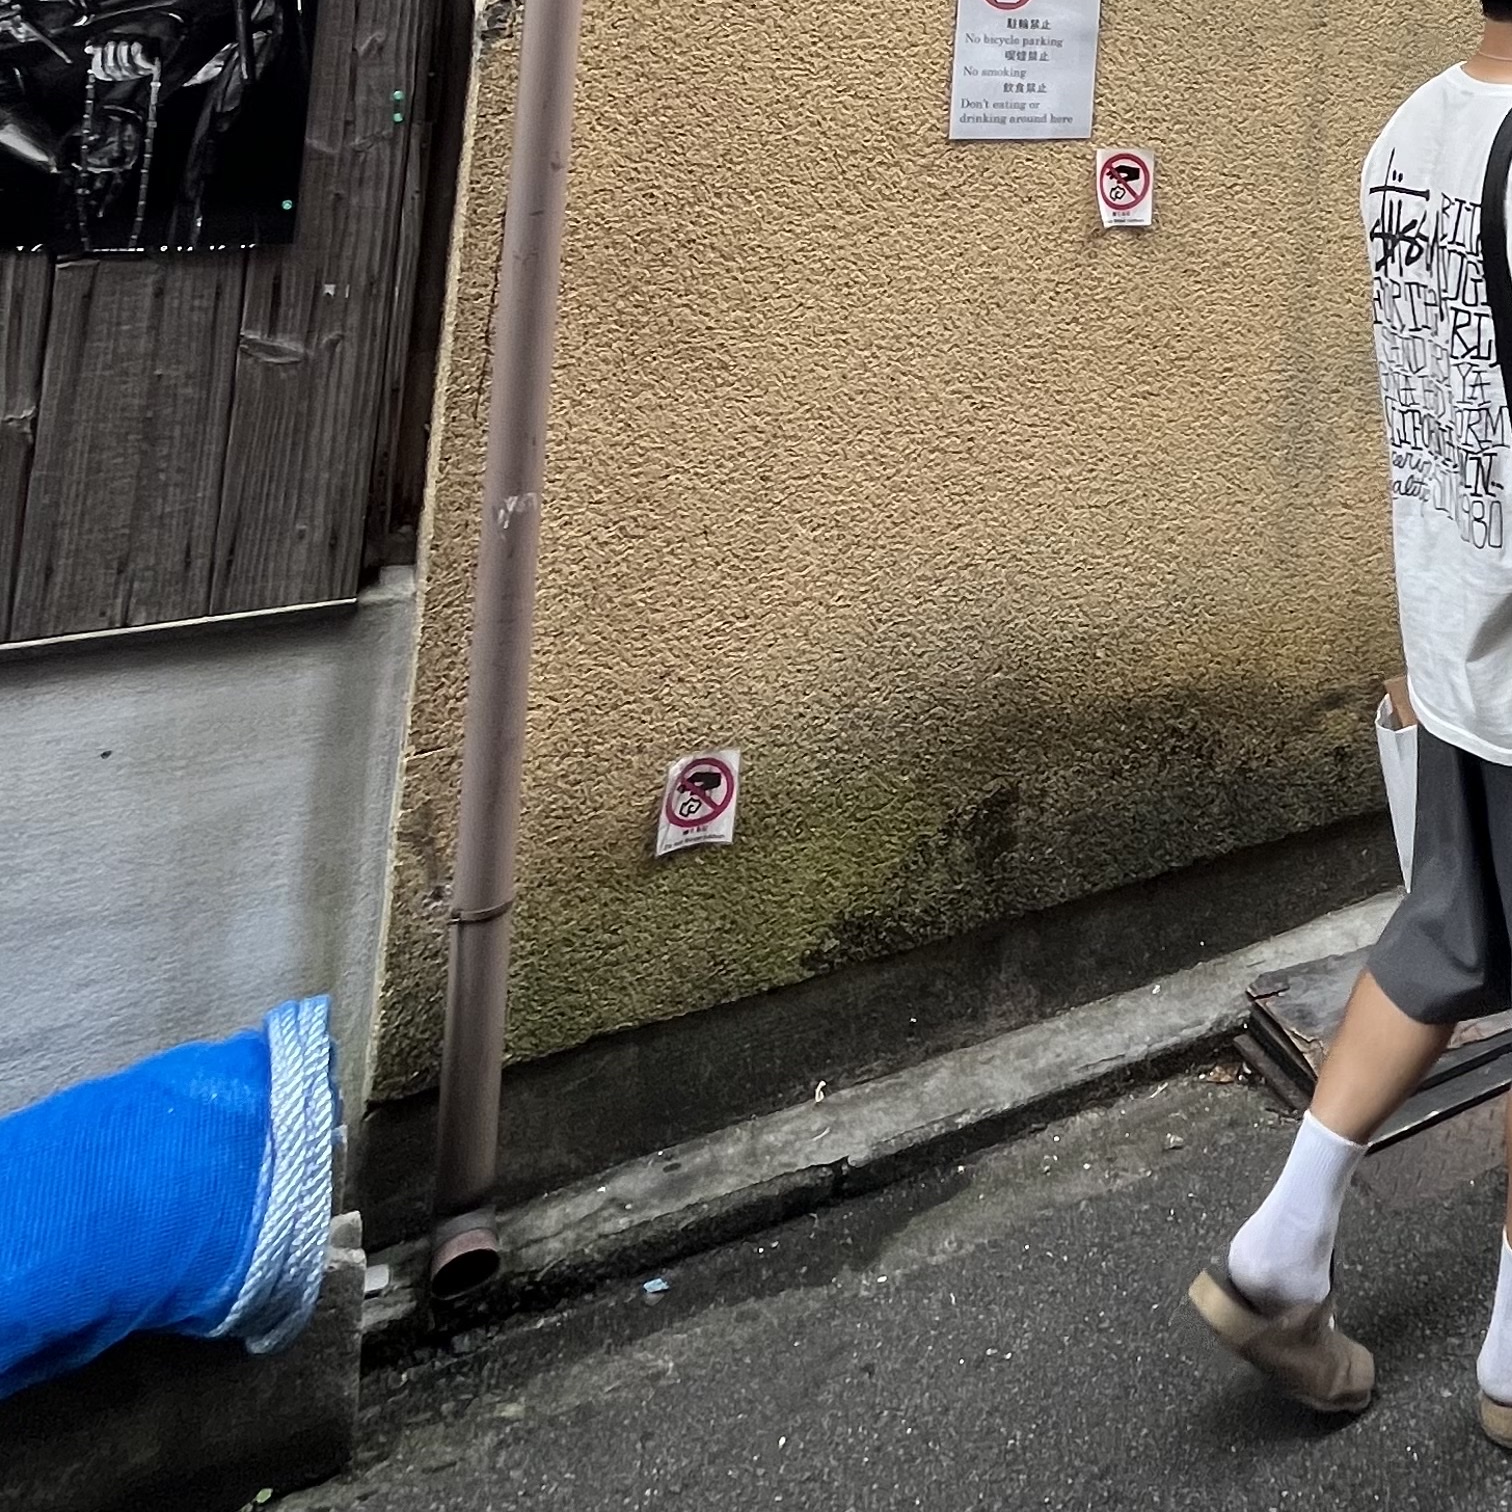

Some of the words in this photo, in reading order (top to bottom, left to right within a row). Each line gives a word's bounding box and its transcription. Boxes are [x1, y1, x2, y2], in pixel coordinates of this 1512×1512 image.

[1006, 18, 1051, 30] 駐輪禁止
[965, 32, 981, 44] No
[983, 33, 1020, 47] bicycle
[1022, 35, 1064, 48] parking
[1004, 50, 1050, 62] 喫煙禁止
[963, 66, 979, 76] No
[981, 67, 1027, 79] smoking
[1002, 82, 1048, 94] 飲食禁止
[961, 98, 989, 109] Don't
[992, 99, 1026, 110] eating
[1028, 101, 1041, 109] or
[959, 113, 1007, 125] drinking
[1009, 113, 1048, 124] around
[1050, 113, 1073, 124] here
